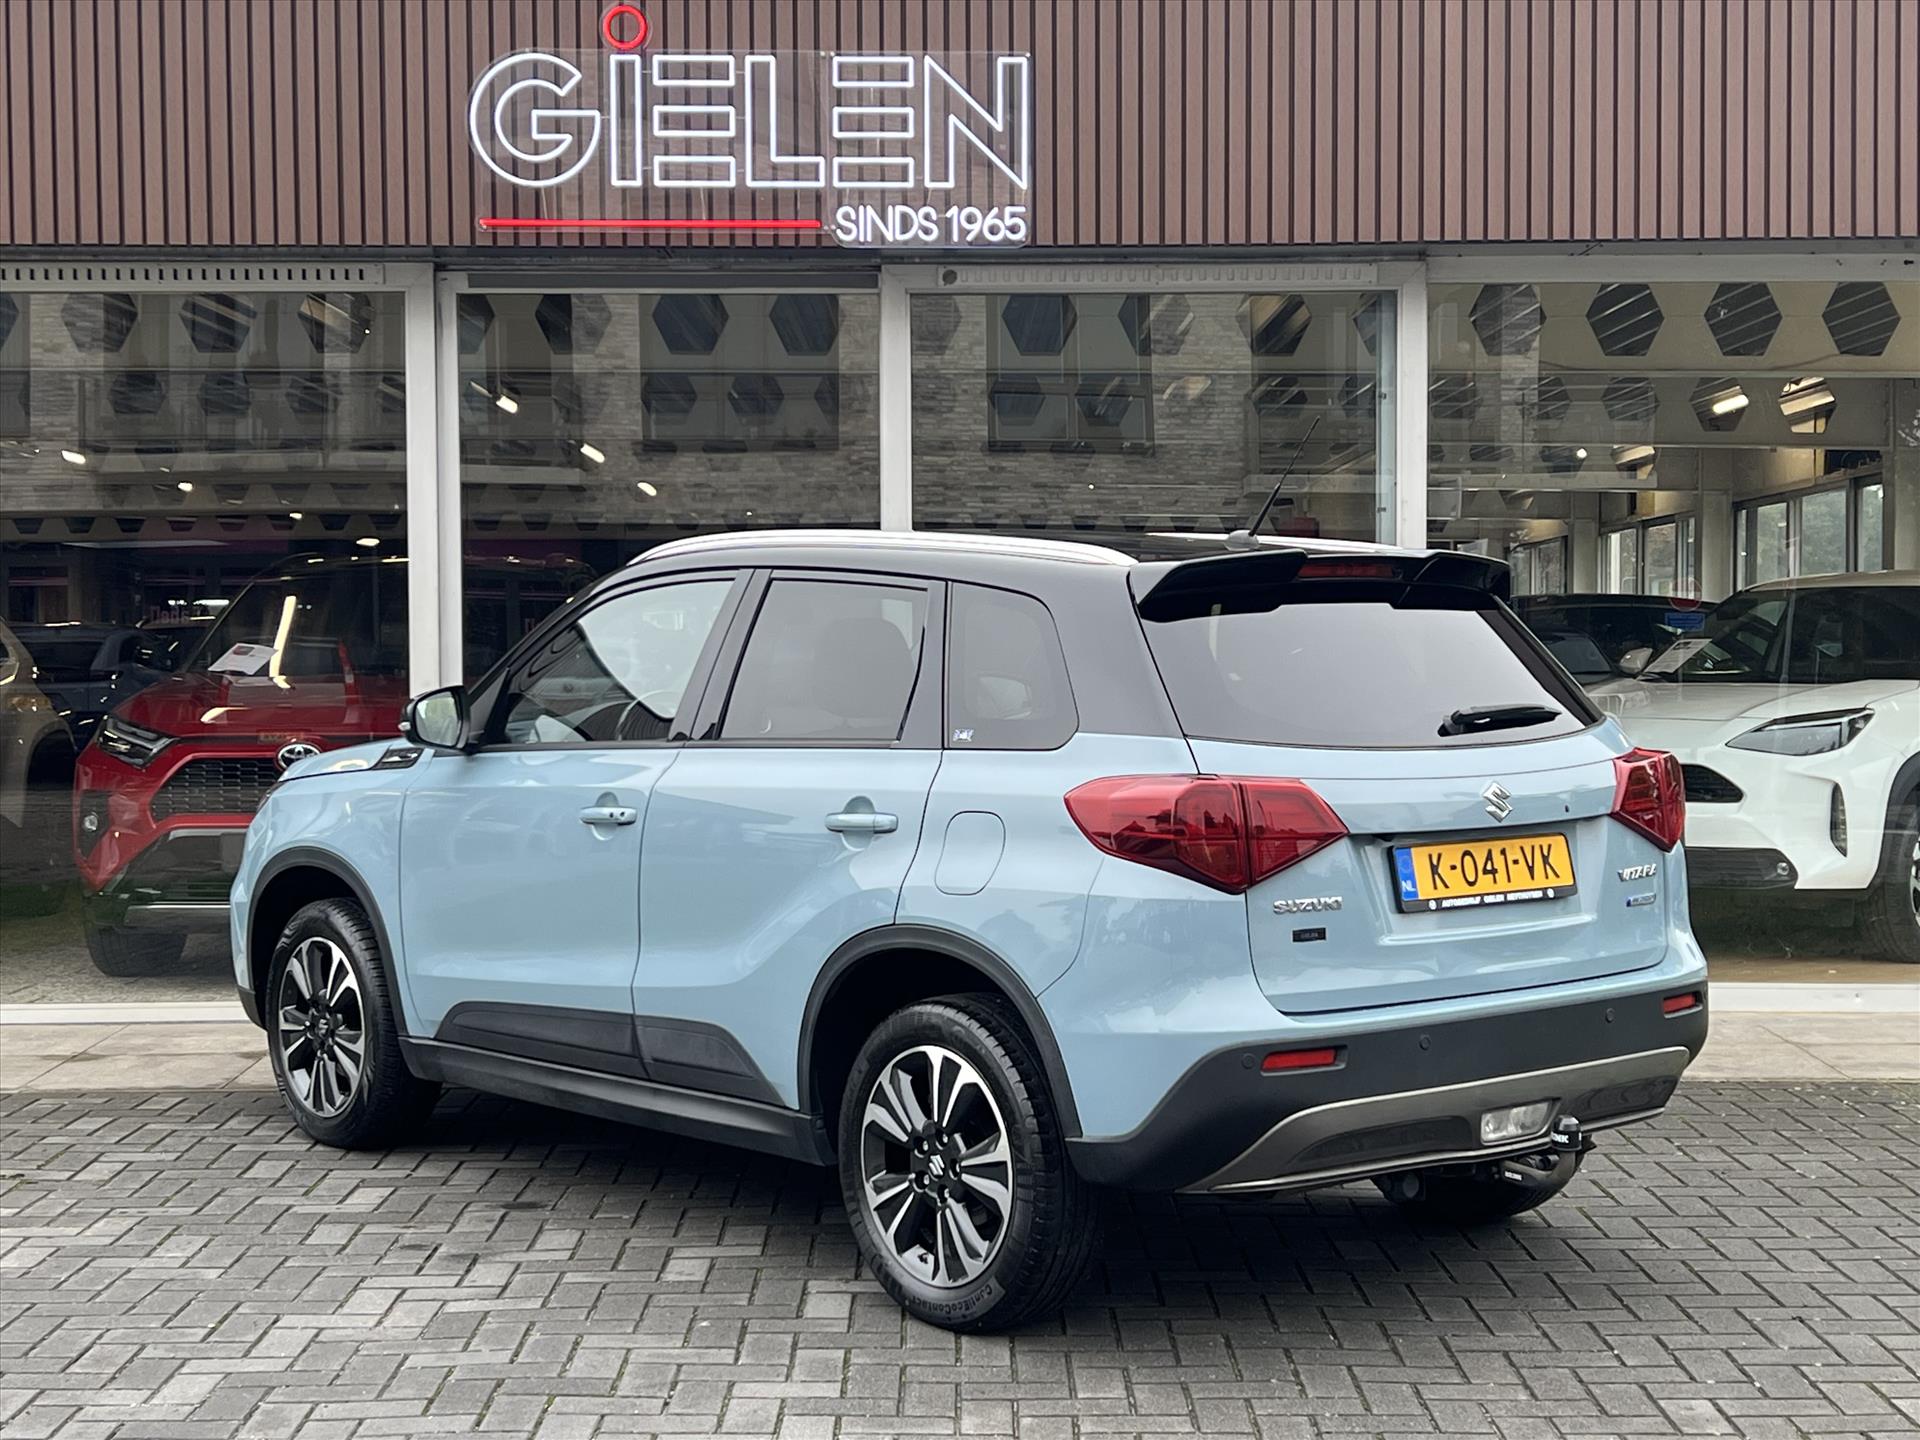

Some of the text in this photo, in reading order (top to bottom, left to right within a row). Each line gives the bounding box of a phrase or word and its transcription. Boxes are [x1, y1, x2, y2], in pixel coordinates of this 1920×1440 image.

[835, 205, 1027, 242] SINDS 1965
[1427, 843, 1561, 890] K-041-VK
[1401, 879, 1416, 892] NL
[1273, 896, 1343, 915] SUZUKI
